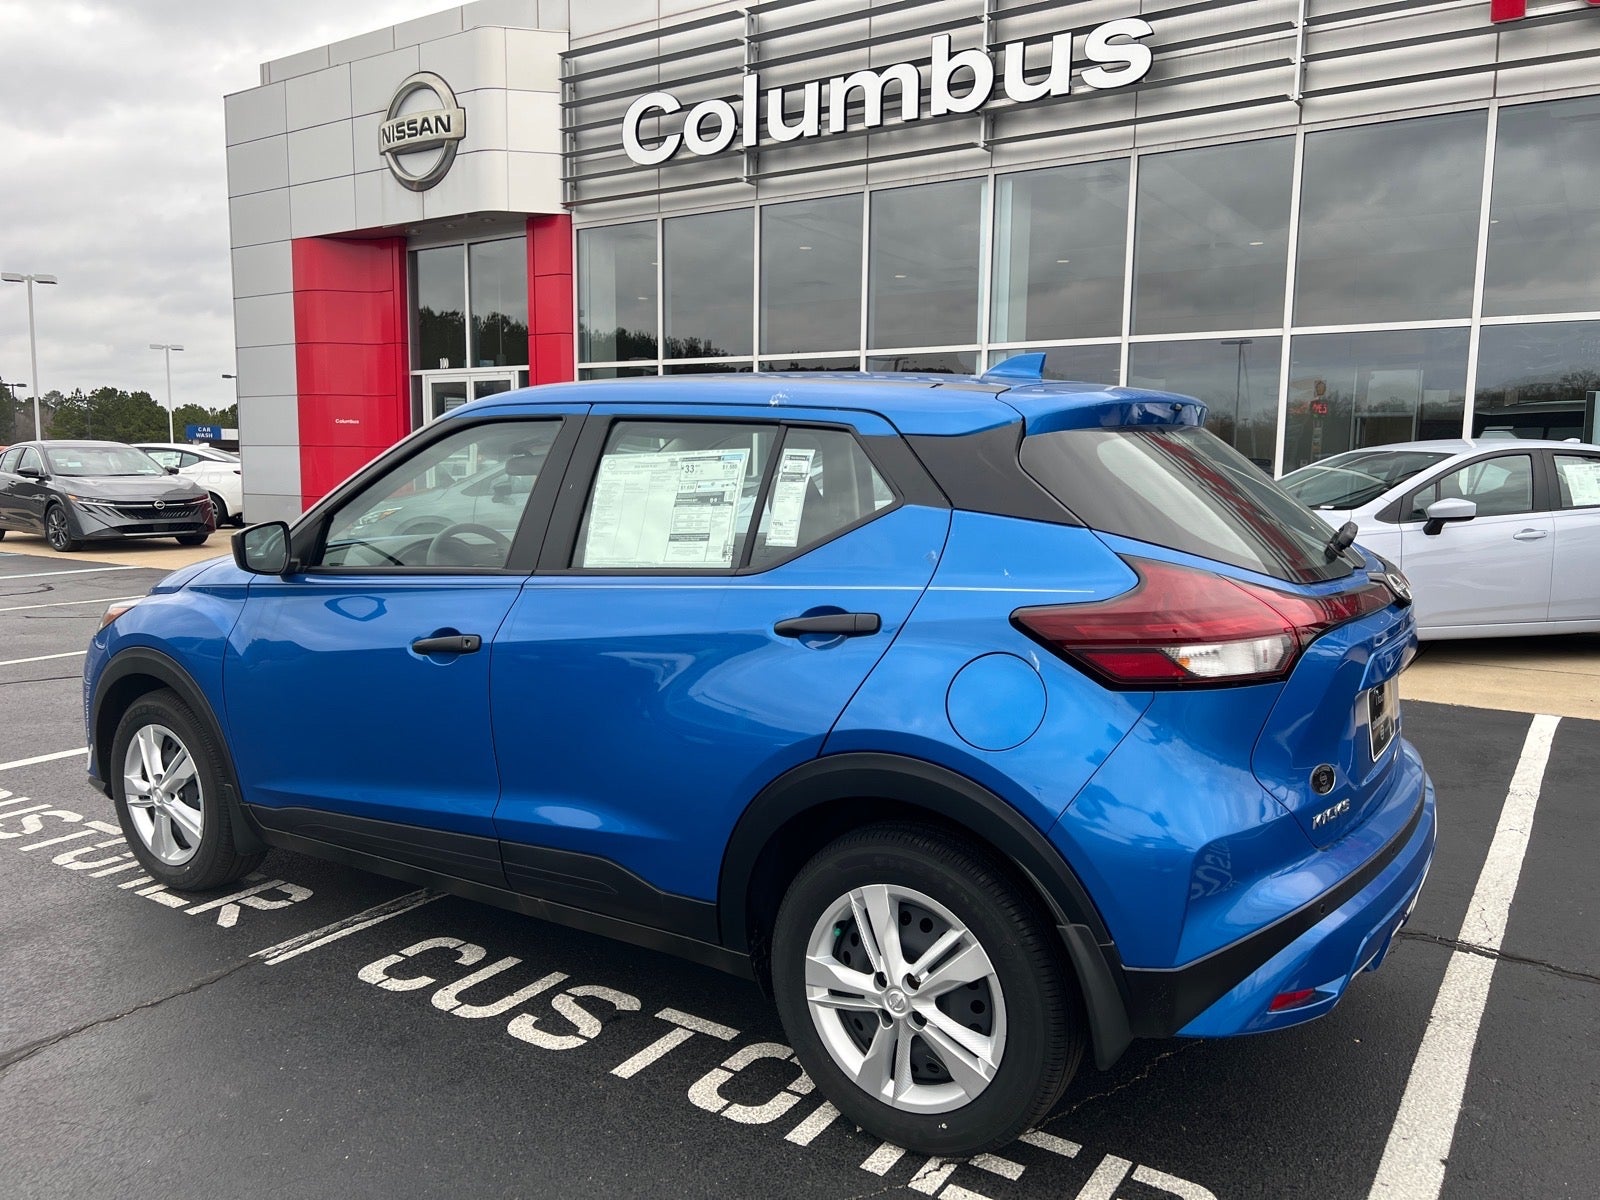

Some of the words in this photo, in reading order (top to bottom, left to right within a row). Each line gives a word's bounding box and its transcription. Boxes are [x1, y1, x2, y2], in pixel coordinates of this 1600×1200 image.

[621, 17, 1155, 166] Columbus
[381, 114, 451, 146] NISSAN
[684, 464, 695, 474] 33
[1312, 798, 1350, 830] KICKS
